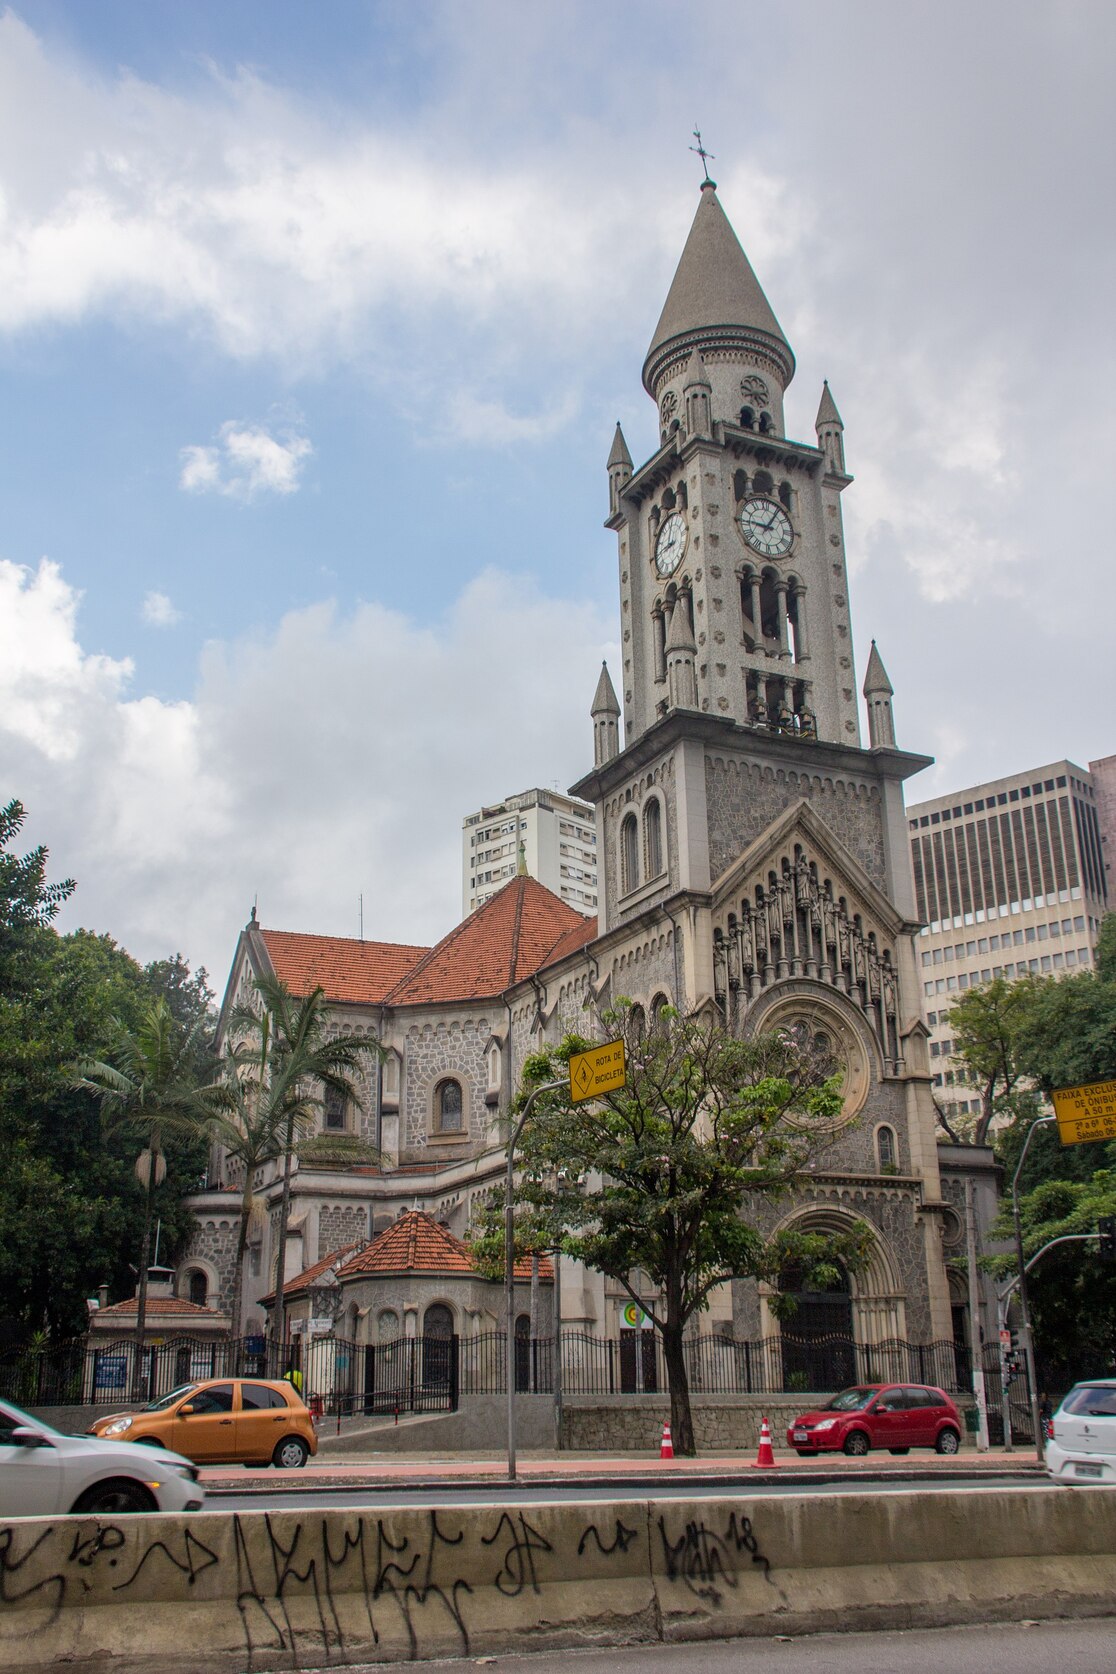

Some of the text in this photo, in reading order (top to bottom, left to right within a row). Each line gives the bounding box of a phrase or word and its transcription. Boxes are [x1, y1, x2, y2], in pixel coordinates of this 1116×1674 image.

[596, 1051, 621, 1066] ROTA DE
[595, 1068, 623, 1084] BICICLETA
[1057, 1090, 1082, 1101] FAIXA
[1075, 1100, 1086, 1108] DE
[1092, 1106, 1103, 1115] 50
